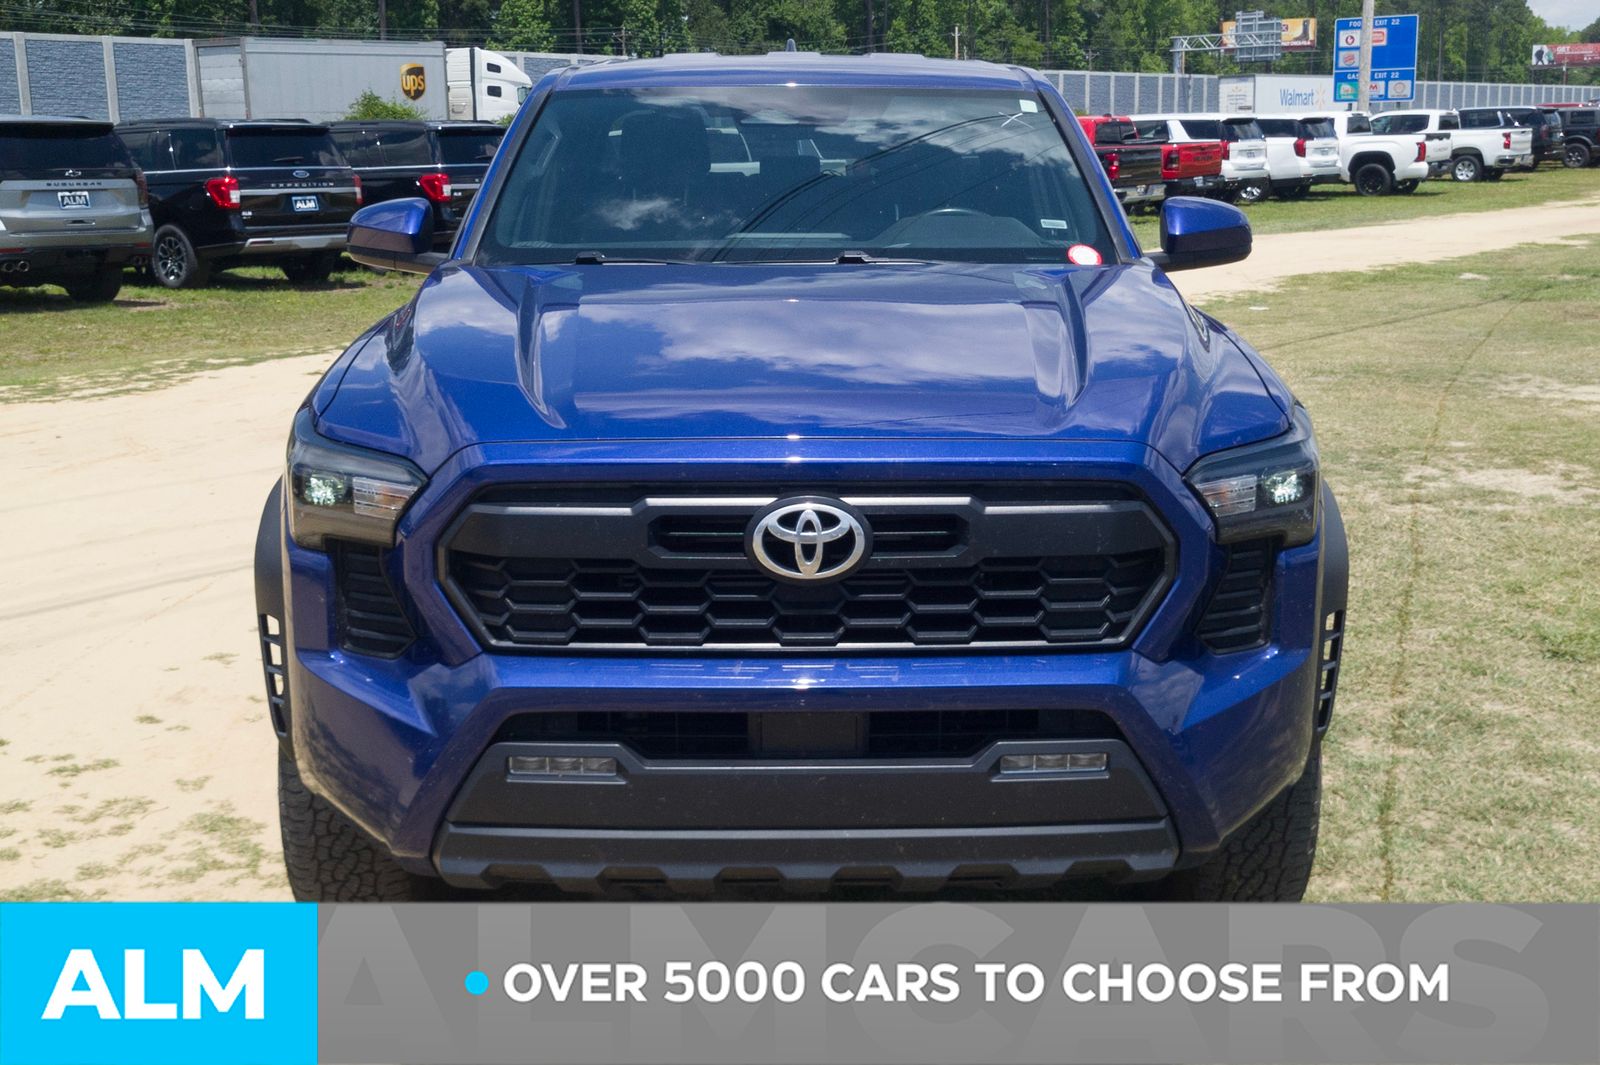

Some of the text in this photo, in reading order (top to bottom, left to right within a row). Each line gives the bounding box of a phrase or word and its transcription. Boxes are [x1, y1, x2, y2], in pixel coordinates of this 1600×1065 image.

[402, 75, 425, 97] ups
[1280, 88, 1314, 106] Walmart
[63, 195, 87, 205] ALM
[295, 200, 316, 209] ALM
